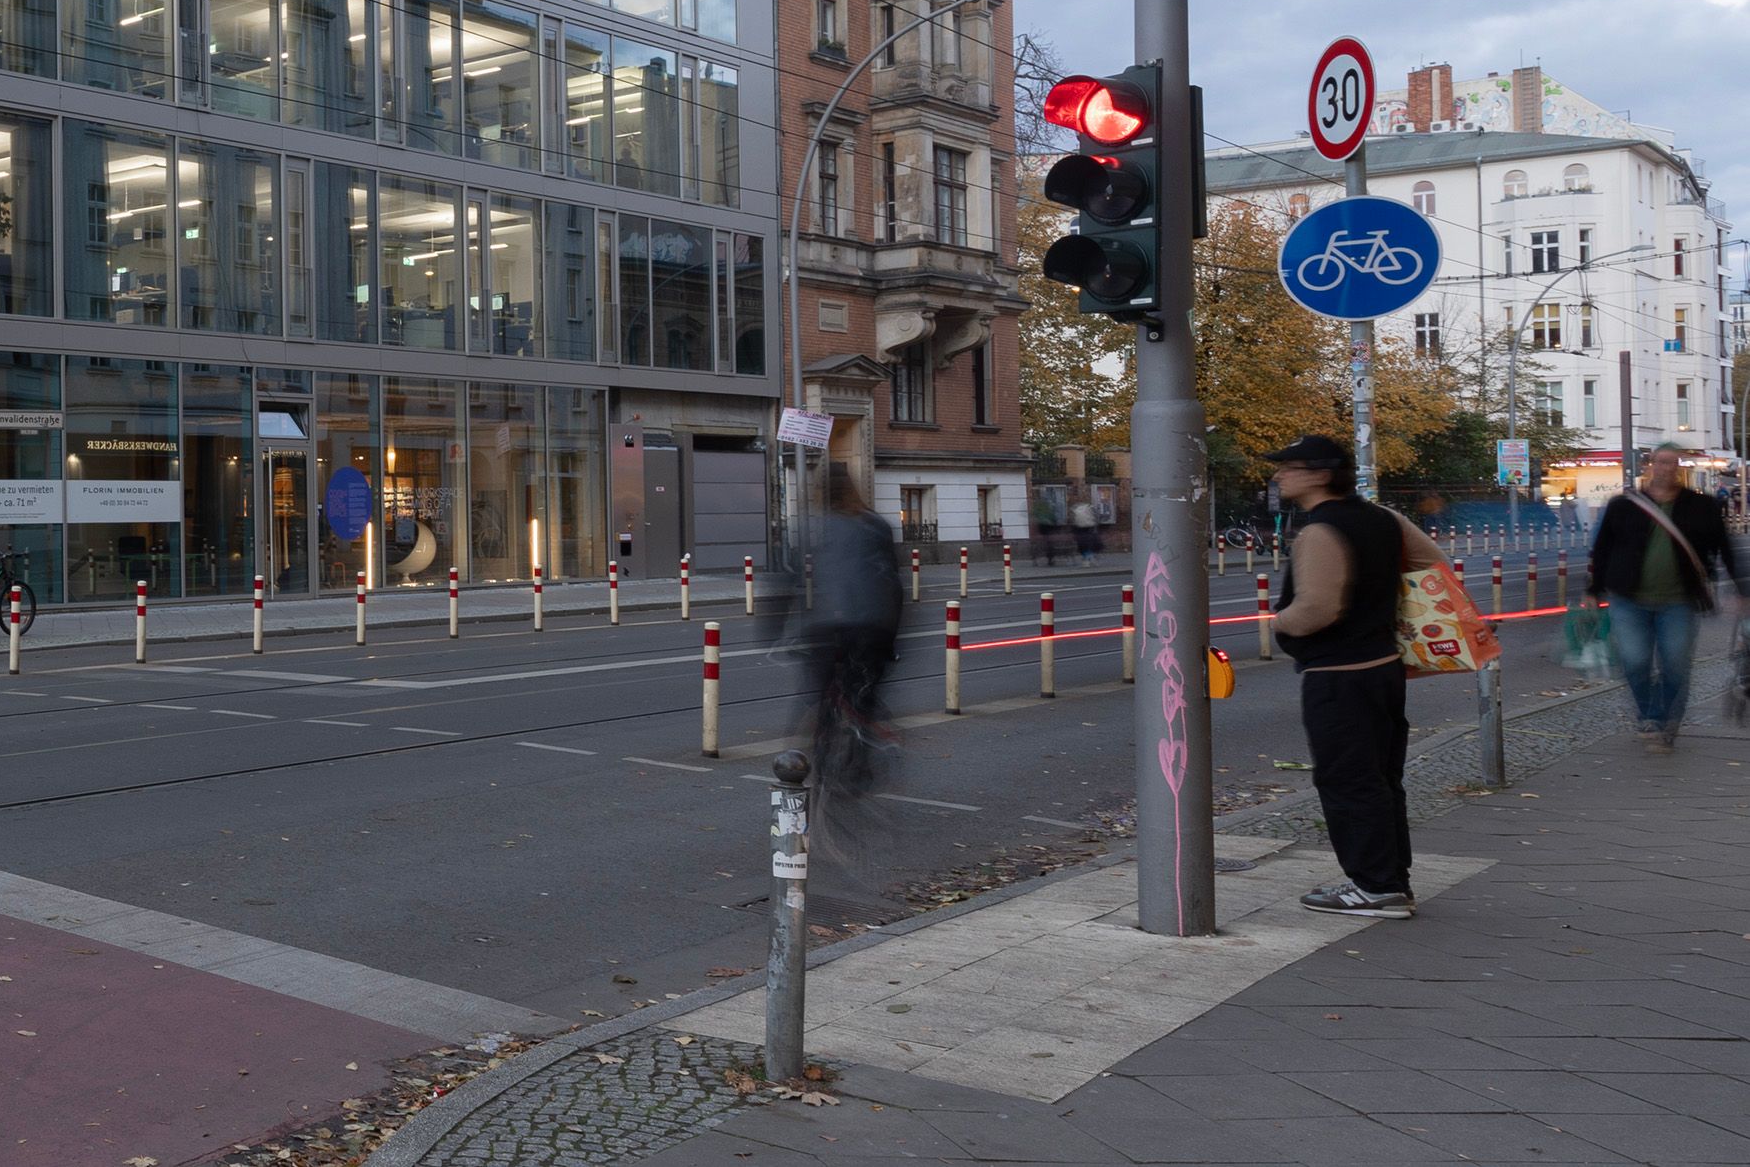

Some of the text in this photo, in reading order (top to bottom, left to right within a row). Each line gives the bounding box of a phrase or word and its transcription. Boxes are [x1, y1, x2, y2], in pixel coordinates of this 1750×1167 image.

[1321, 68, 1360, 129] 30
[18, 485, 54, 494] vermieten
[17, 498, 25, 507] 71
